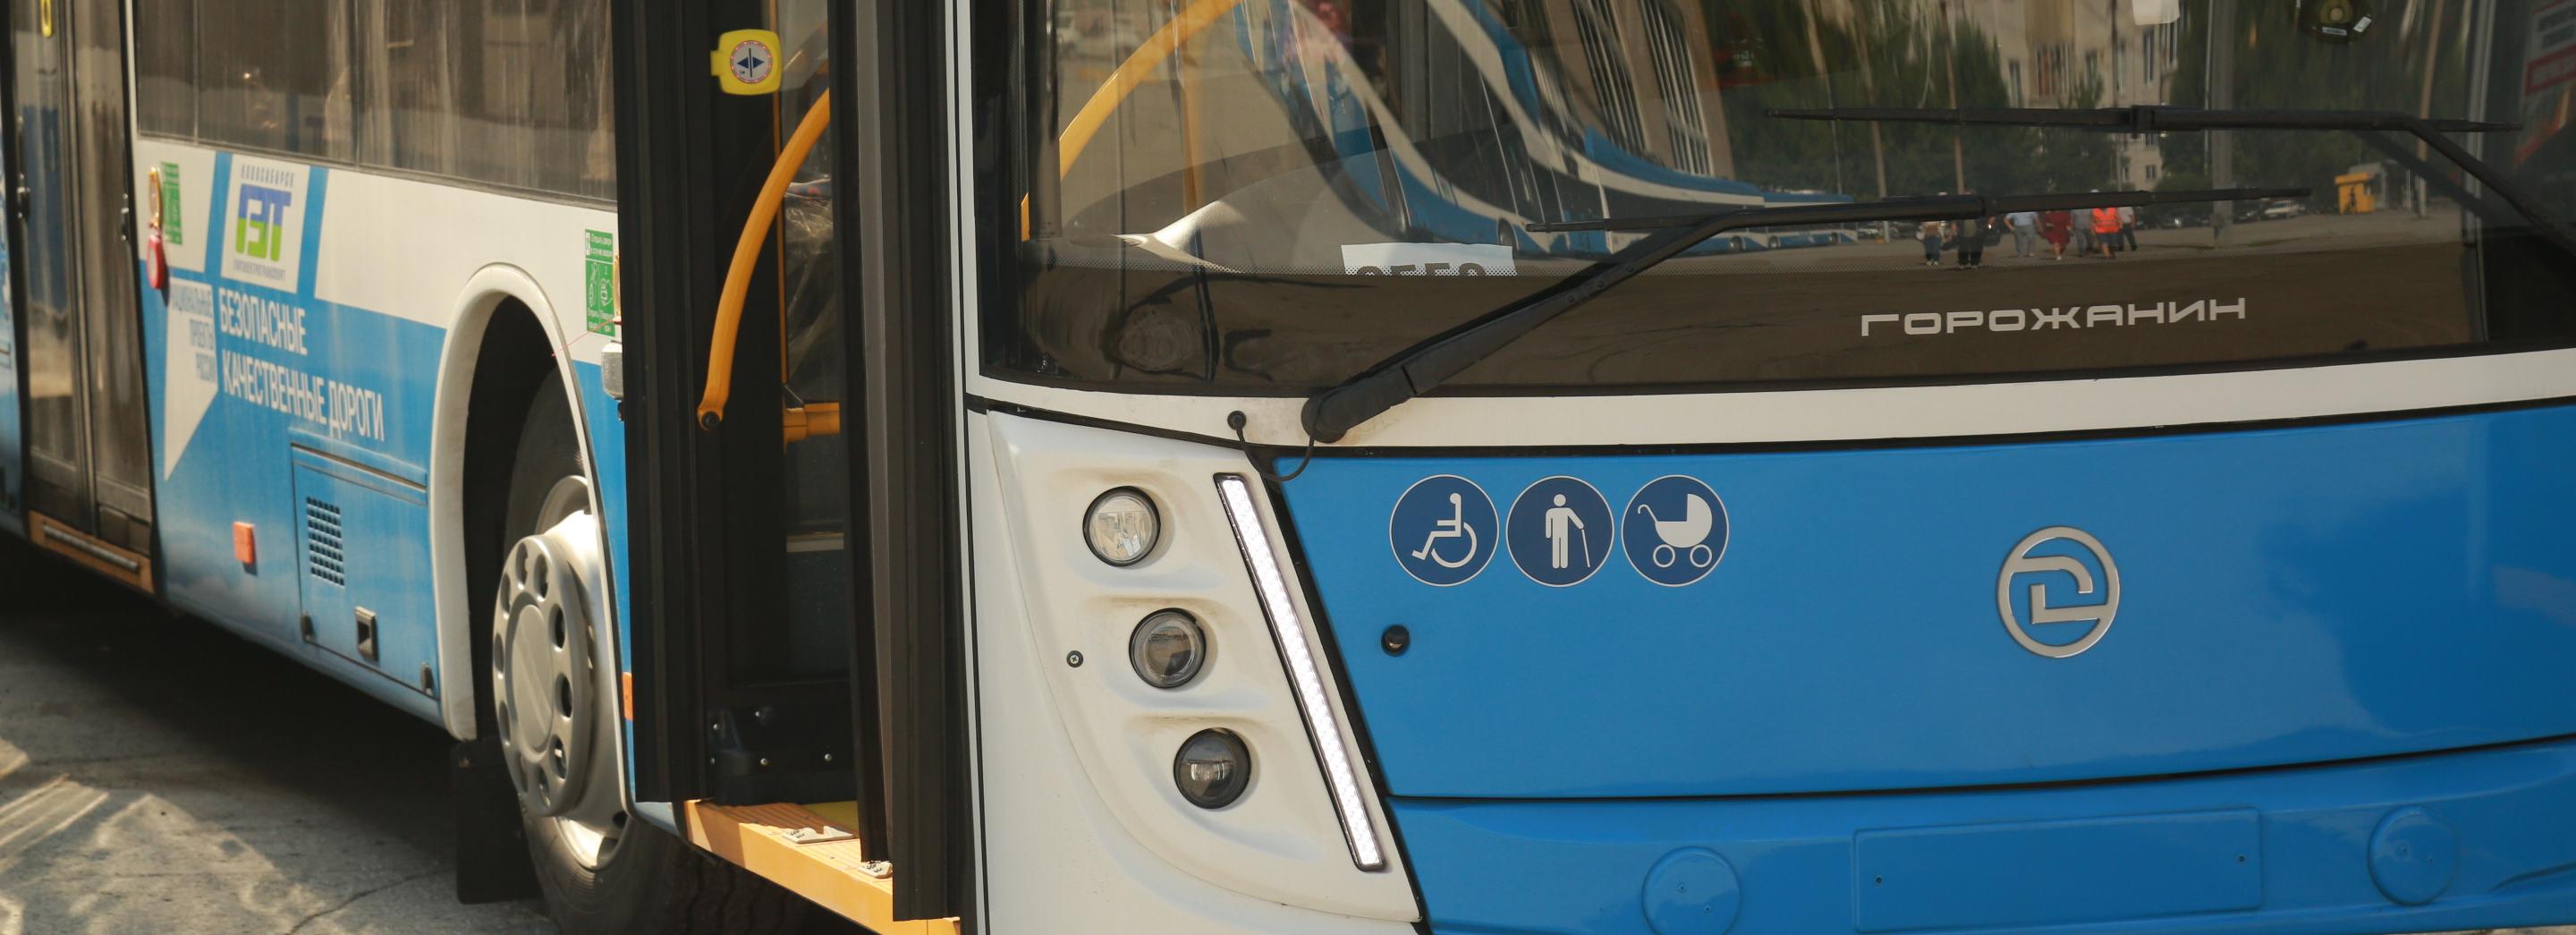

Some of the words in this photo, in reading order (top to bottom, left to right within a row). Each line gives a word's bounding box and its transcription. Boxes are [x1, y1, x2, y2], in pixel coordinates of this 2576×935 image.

[218, 287, 308, 355] БЕЗОПАСНЫЕ
[1860, 297, 2246, 337] ГОРОЖАНИН
[222, 348, 327, 425] КАЧЕСТВЕННЫЕ
[328, 379, 385, 441] ДОРОГИ
